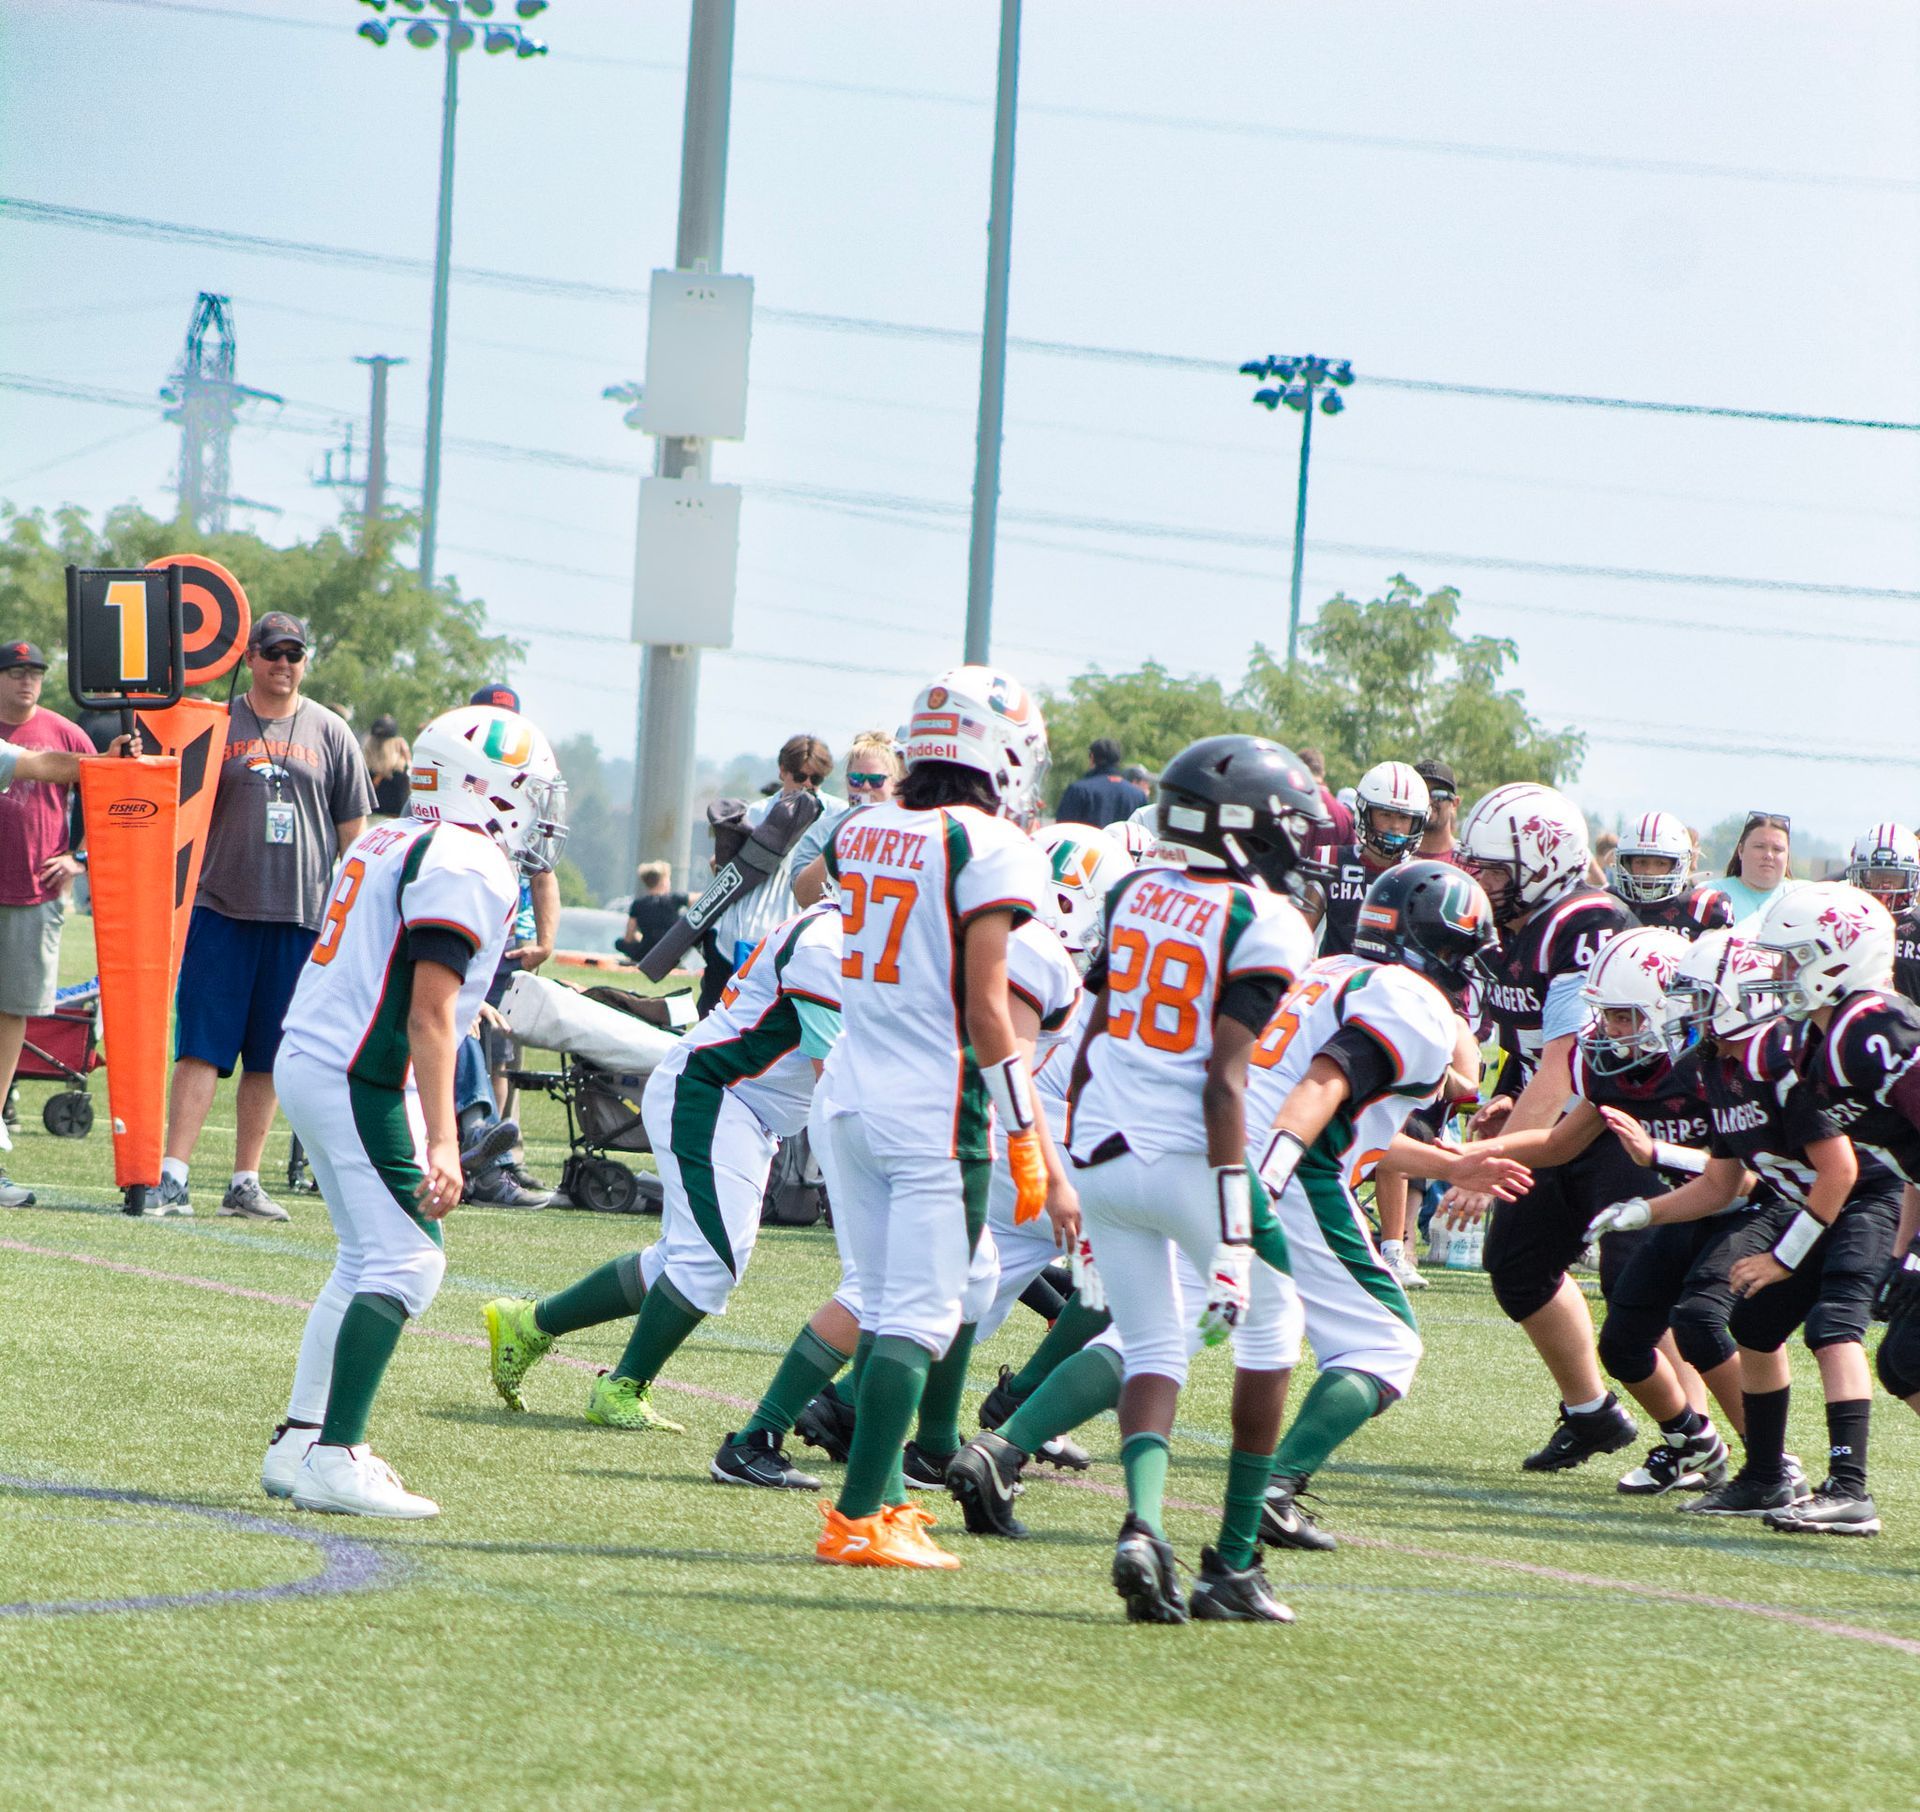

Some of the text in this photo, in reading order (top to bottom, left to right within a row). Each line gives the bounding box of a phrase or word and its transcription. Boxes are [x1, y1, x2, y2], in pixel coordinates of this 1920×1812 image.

[103, 580, 150, 681] 1
[223, 738, 319, 769] BRONCOS
[108, 804, 147, 813] FISHER
[412, 803, 441, 819] dell
[836, 826, 927, 871] GAWRYL
[697, 871, 738, 912] Coleman
[1342, 865, 1365, 883] C
[840, 871, 919, 985] 27
[1129, 882, 1220, 937] SMITH
[1108, 925, 1208, 1054] 28
